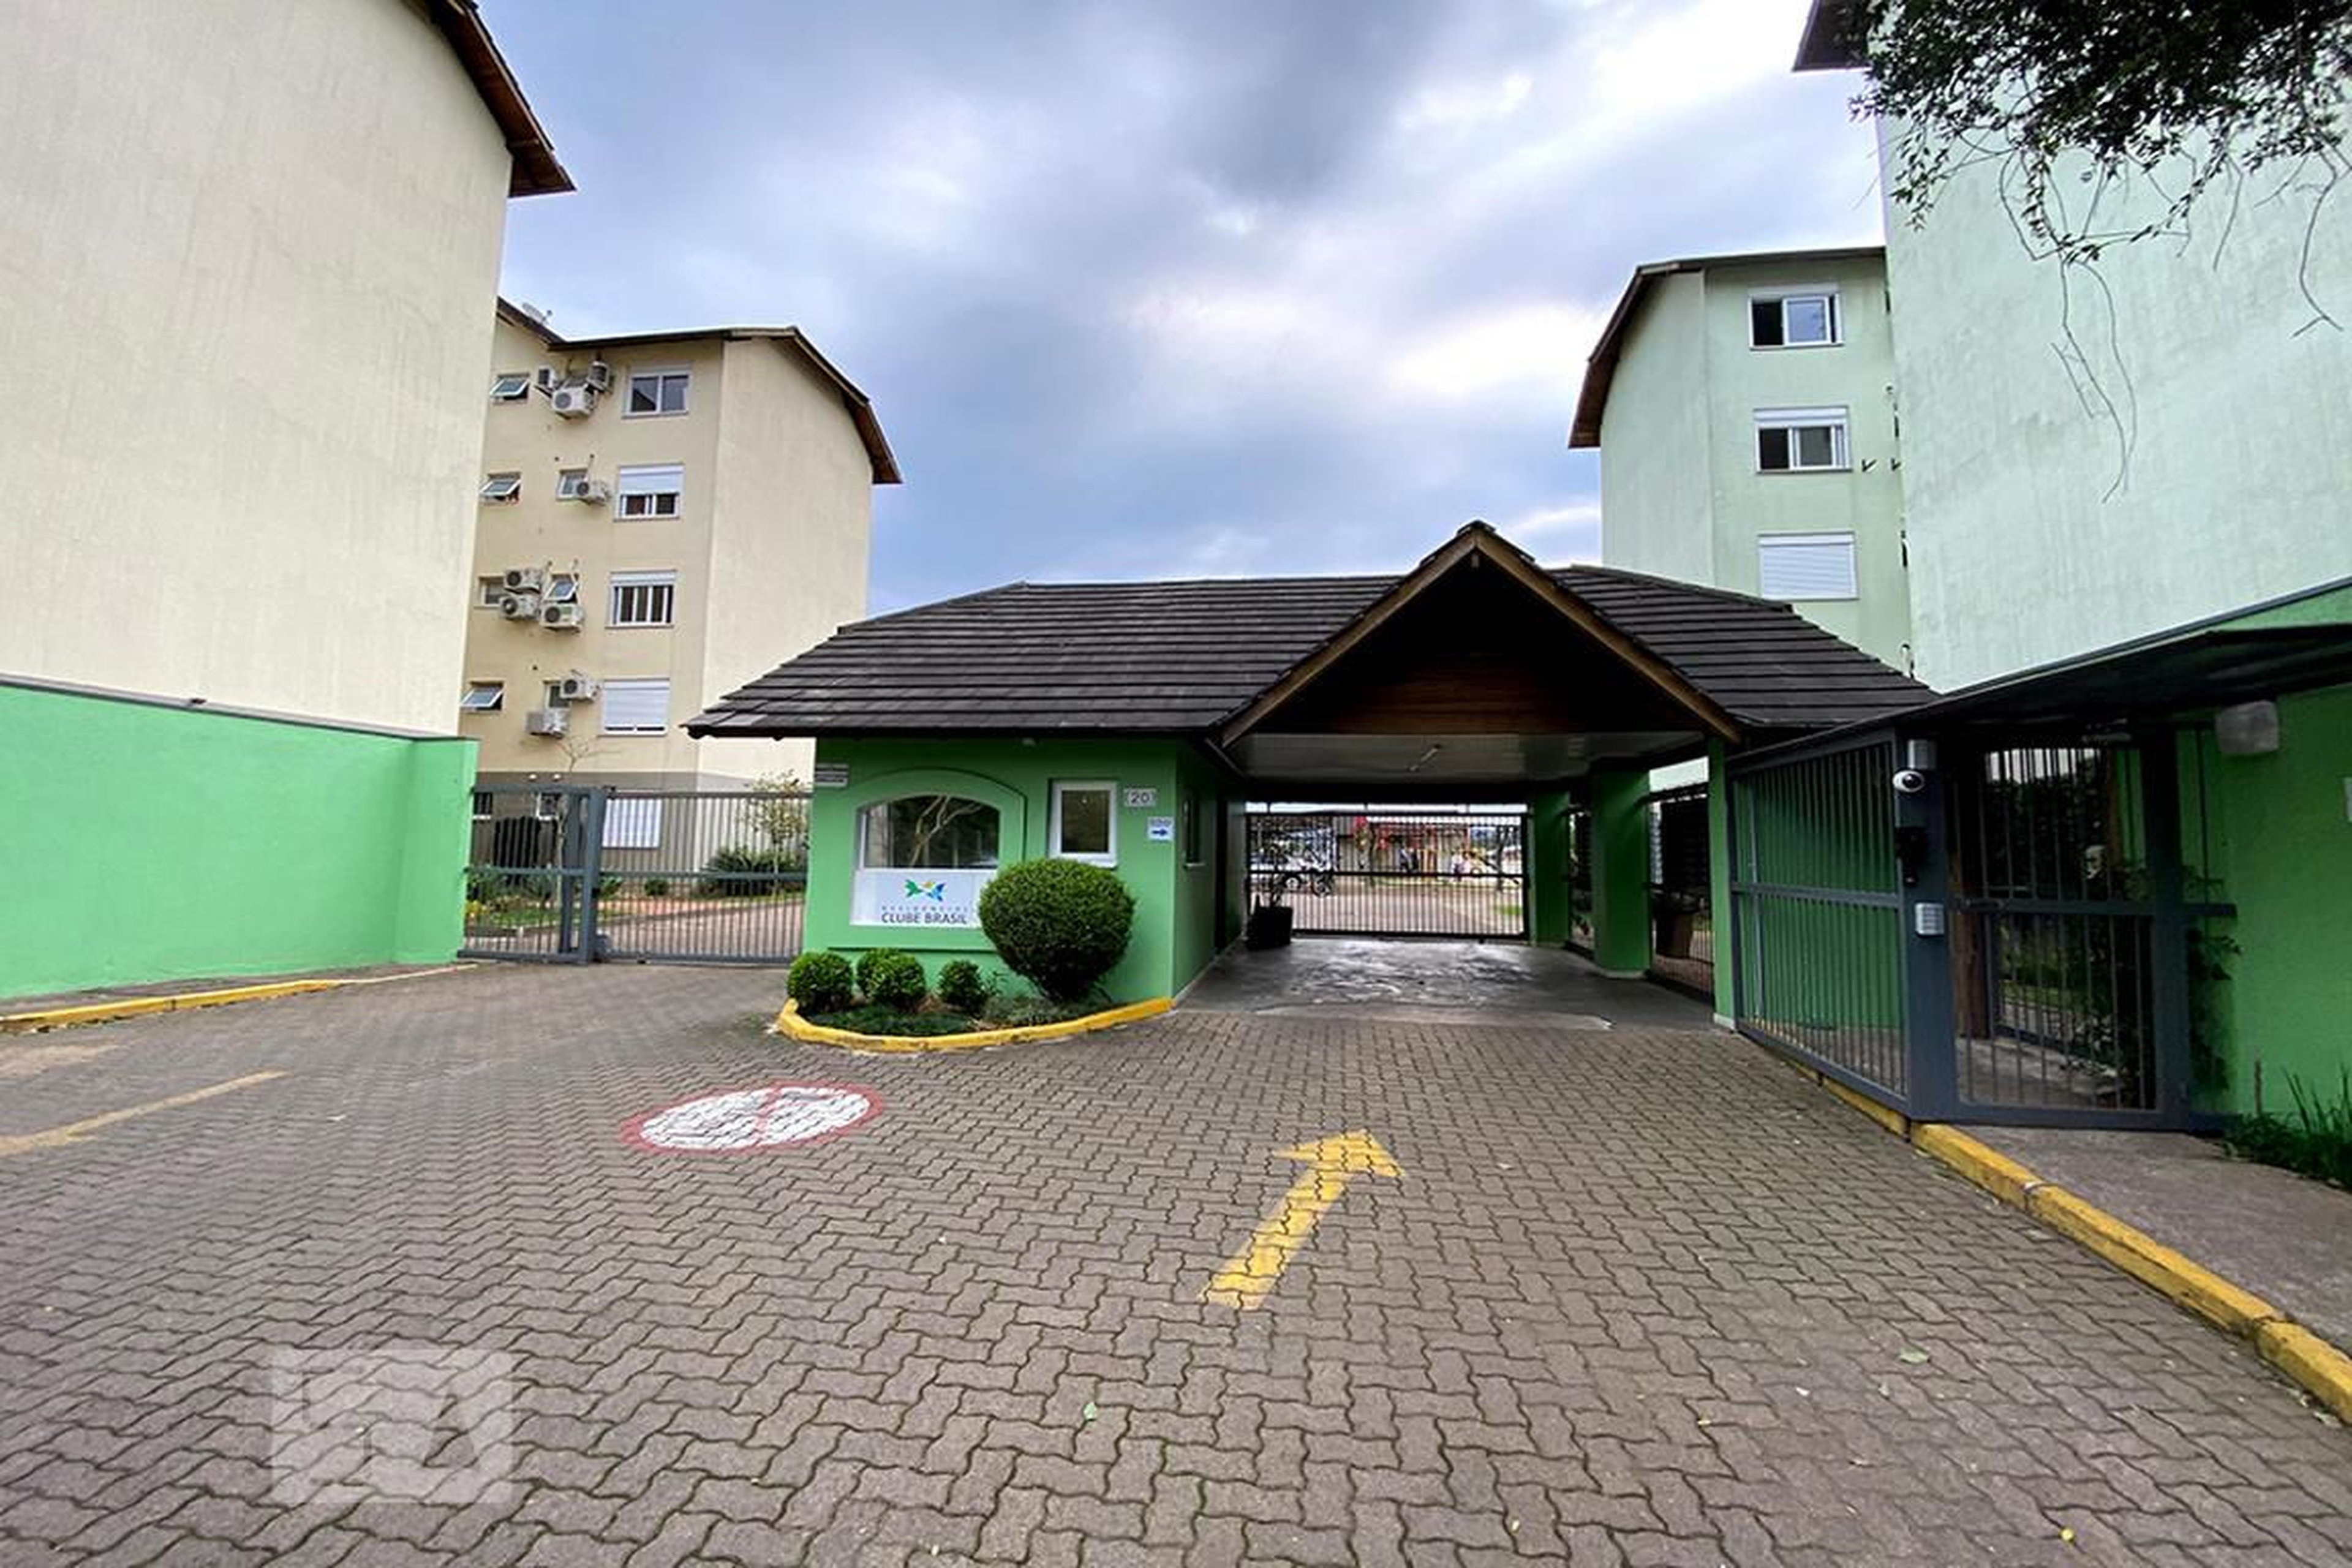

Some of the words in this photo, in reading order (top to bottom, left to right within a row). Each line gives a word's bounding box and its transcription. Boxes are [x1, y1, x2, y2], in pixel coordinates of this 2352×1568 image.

[1131, 791, 1150, 804] 20
[881, 913, 920, 923] CLUBE
[924, 913, 968, 924] BRASIL
